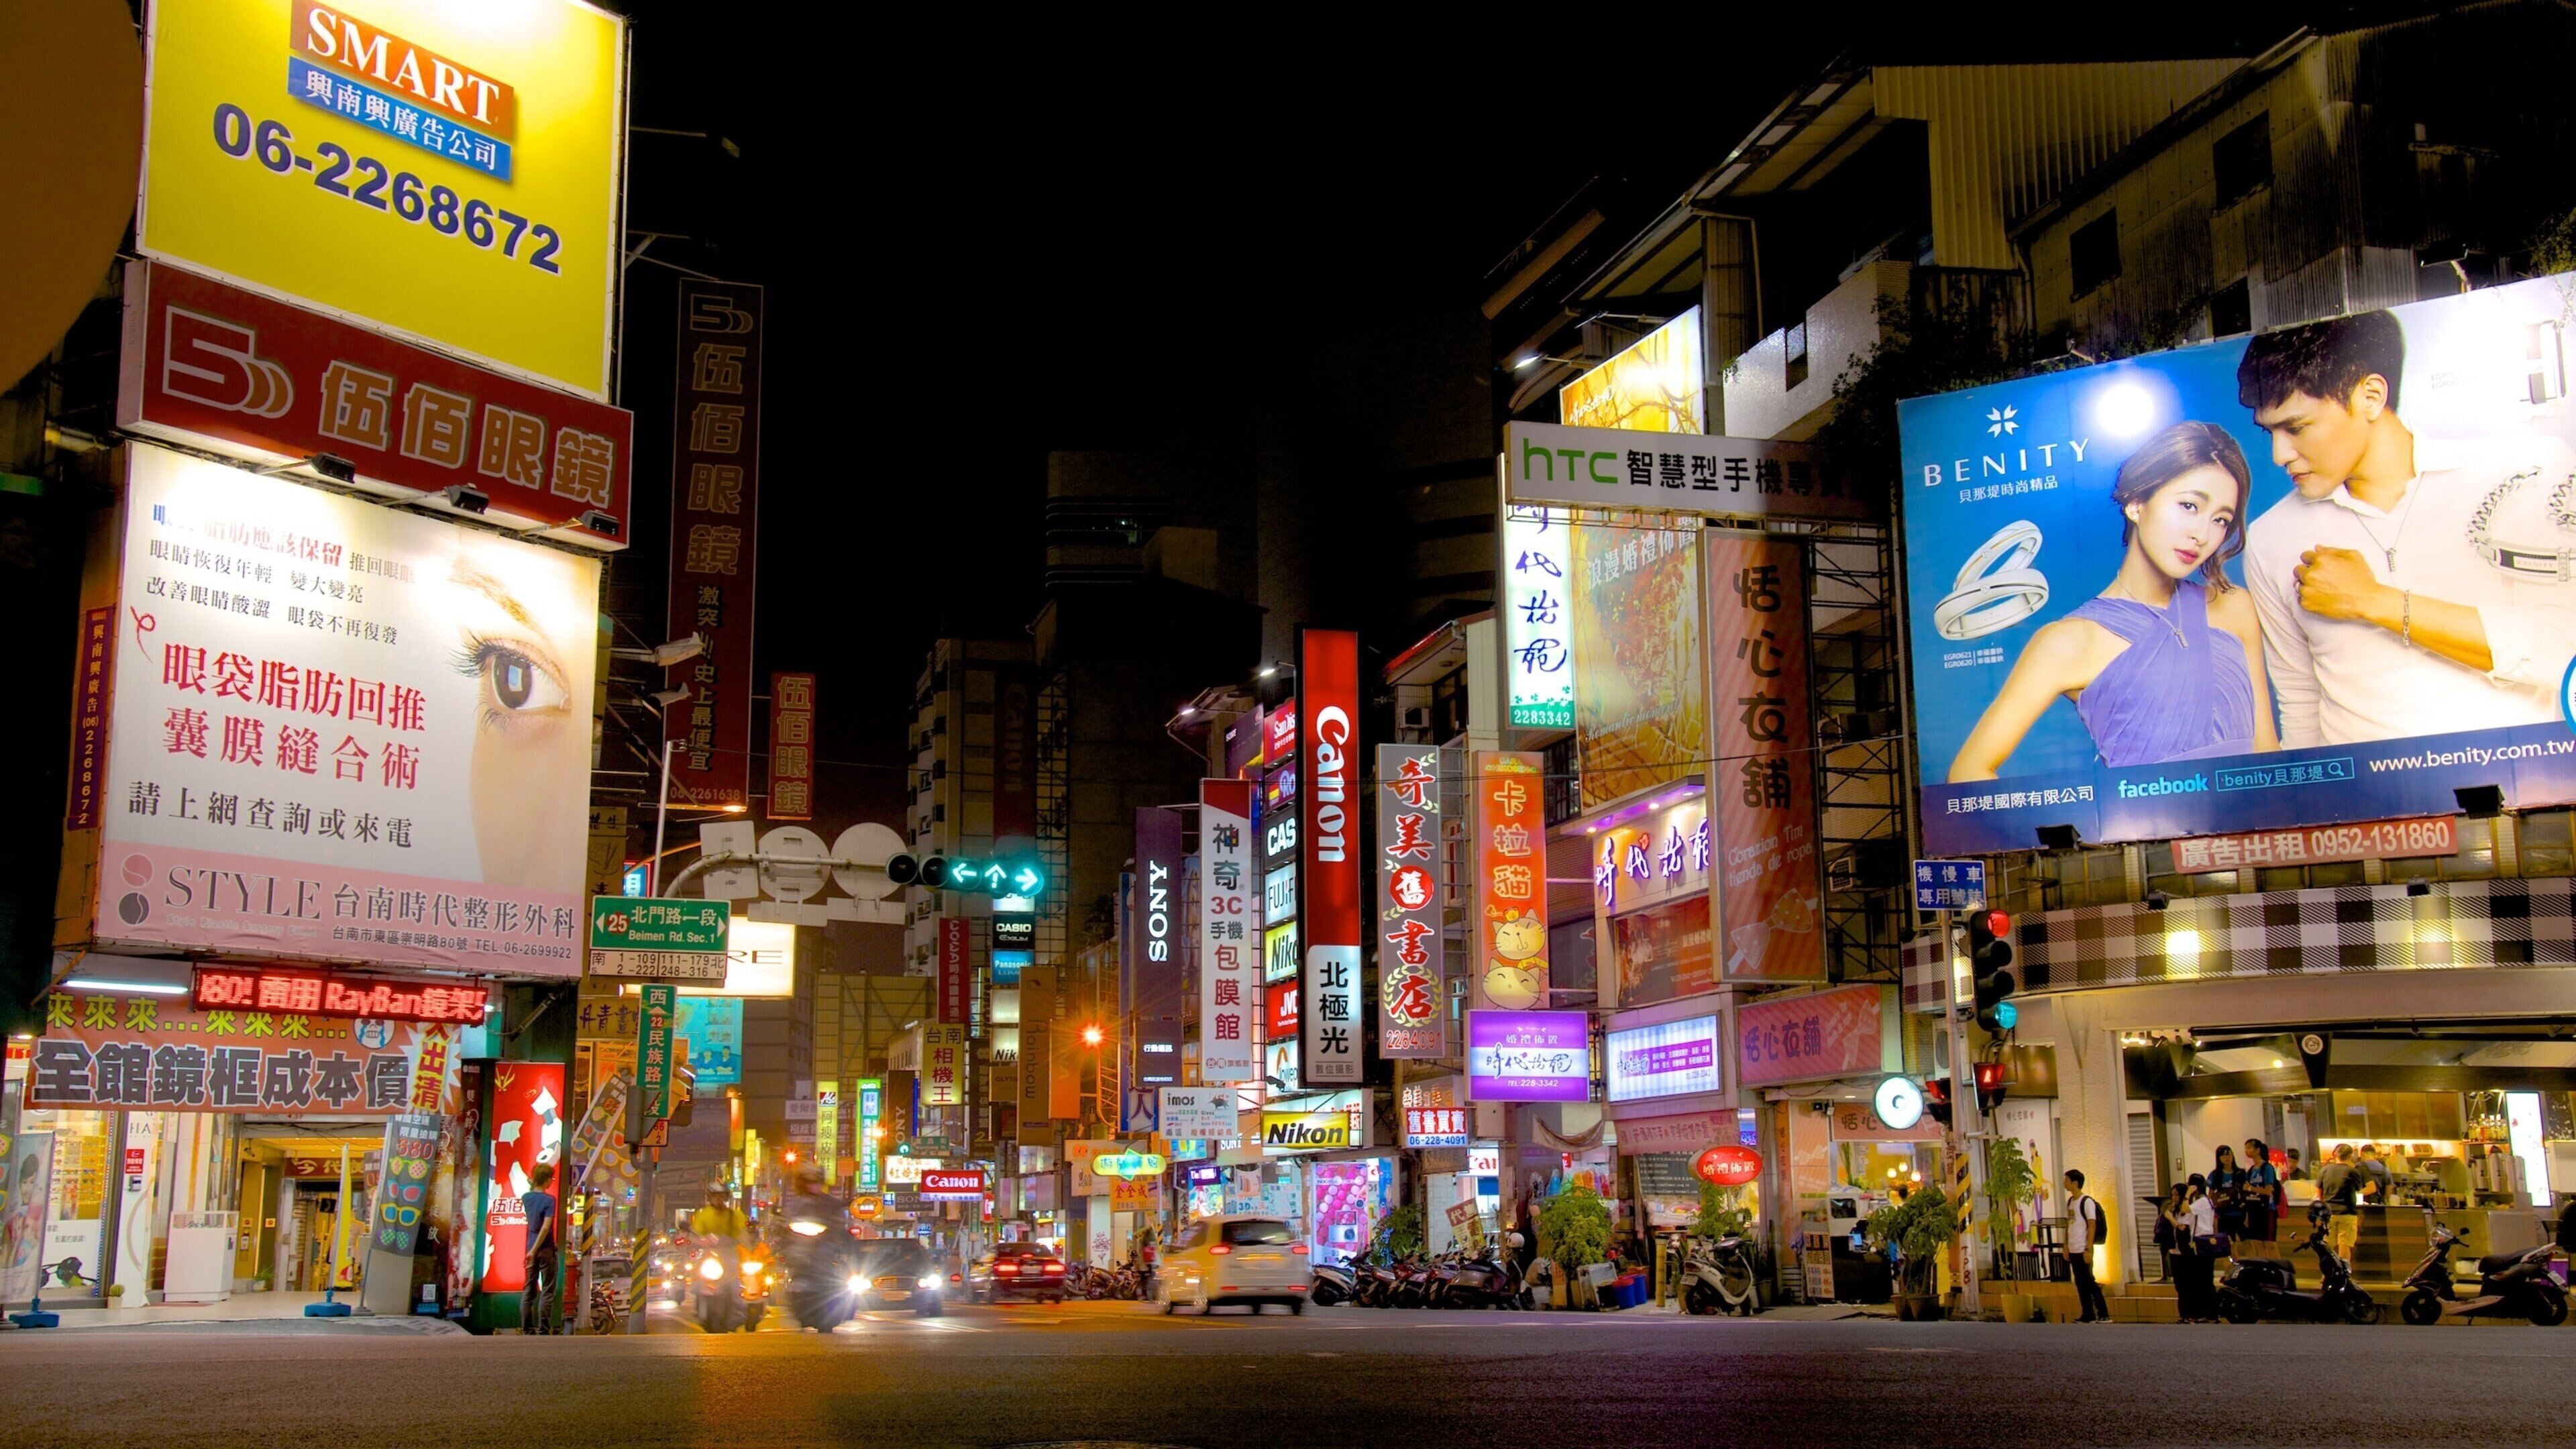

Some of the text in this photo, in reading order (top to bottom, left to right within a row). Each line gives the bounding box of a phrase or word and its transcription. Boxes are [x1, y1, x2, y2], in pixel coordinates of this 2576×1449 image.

[307, 7, 500, 125] SMART
[306, 70, 496, 171] 興南興廣告公司
[213, 103, 563, 276] 06-2268672
[318, 359, 616, 510] 伍佰眼鏡
[685, 342, 747, 576] 伍佰眼鏡
[1923, 437, 2090, 487] BENITY
[1960, 475, 2058, 504] 貝那堤時尚精品
[153, 504, 343, 567] 脂肪應該保留
[290, 570, 364, 604] 變大變亮
[287, 605, 398, 646] 眼袋不再復發
[163, 642, 426, 733] 眼袋脂肪回推
[1274, 711, 1296, 738] SanDis
[1513, 708, 1570, 726] 2283342
[1586, 712, 1634, 743] Romantic
[163, 706, 421, 790] 囊膜縫合術
[774, 676, 812, 814] 伍佰眼鏡
[2369, 739, 2575, 773] www.benity.com.tw
[670, 786, 741, 800] 062261638
[1316, 705, 1350, 863] Canon
[2118, 773, 2209, 798] facebook
[127, 780, 412, 849] 請上網查詢或來電
[1946, 786, 2094, 815] 貝那堤國際有限公司
[1267, 816, 1296, 857] CAS
[1493, 780, 1532, 900] 卡拉貓
[1728, 836, 1778, 866] Corazion
[2180, 820, 2450, 868] 廣告出租 0952-131860
[1729, 843, 1813, 888] tienda de ropa
[1917, 865, 1982, 883] 機慢車
[166, 866, 322, 920] STYLE
[1384, 756, 1436, 1021] 奇美舊書店
[1919, 888, 1983, 906] 專用號誌
[333, 883, 576, 940] 台南時代整形外科
[607, 914, 628, 932] 25
[631, 906, 717, 926] 北門路一段
[1148, 860, 1169, 963] SONY
[629, 930, 715, 943] Beimen Rd. Sec. 1
[996, 922, 1032, 933] CASIO
[331, 926, 572, 959] 台南市東區崇明路80號 TEL:06-2699922
[1271, 936, 1298, 973] Niko
[591, 952, 605, 966] 南
[661, 954, 710, 966] 111-179
[661, 965, 708, 977] 248-316
[710, 954, 724, 970] 北
[995, 960, 1032, 969] Panasonic
[649, 989, 667, 1006] 西
[1319, 961, 1350, 1055] 北極光
[651, 1016, 663, 1028] 22
[926, 1028, 962, 1044] 台南
[1385, 1030, 1442, 1050] 2284091
[1505, 1034, 1558, 1045] 婚禮佈置
[995, 1049, 1018, 1061] Nik
[1315, 1063, 1354, 1074] 數位攝影
[32, 1039, 409, 1111] 全館鏡框成本價
[932, 1047, 954, 1103] 相機王
[1167, 1093, 1195, 1106] imos
[1268, 1123, 1344, 1144] Nikon
[1407, 1109, 1465, 1134] 舊書買賣
[1409, 1136, 1466, 1146] 06-228-4091
[925, 1175, 979, 1188] Canon
[1703, 1161, 1756, 1176] 婚禮佈置
